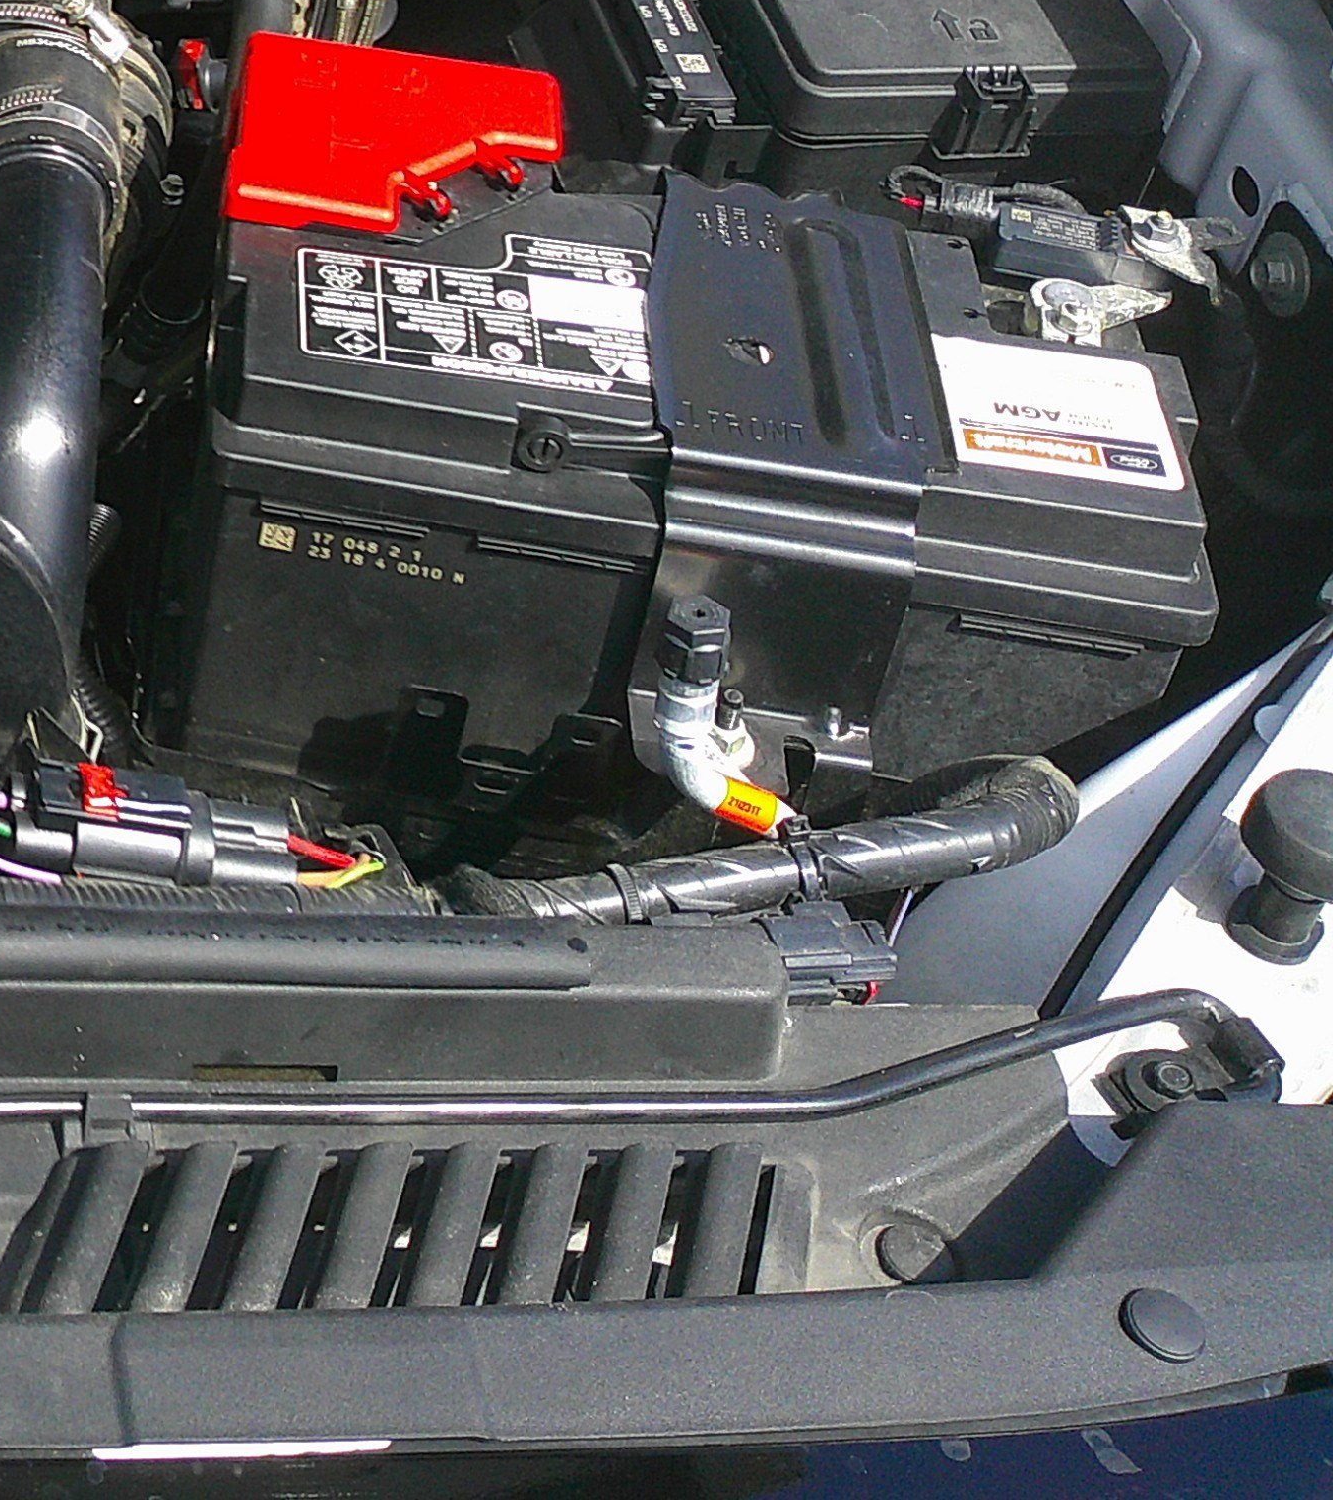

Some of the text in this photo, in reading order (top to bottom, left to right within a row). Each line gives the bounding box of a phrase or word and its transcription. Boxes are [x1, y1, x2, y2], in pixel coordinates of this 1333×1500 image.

[994, 402, 1061, 422] AGM
[312, 531, 334, 545] 17
[388, 545, 401, 558] 2
[308, 545, 332, 559] 23
[397, 561, 443, 580] 0010
[452, 571, 465, 584] N
